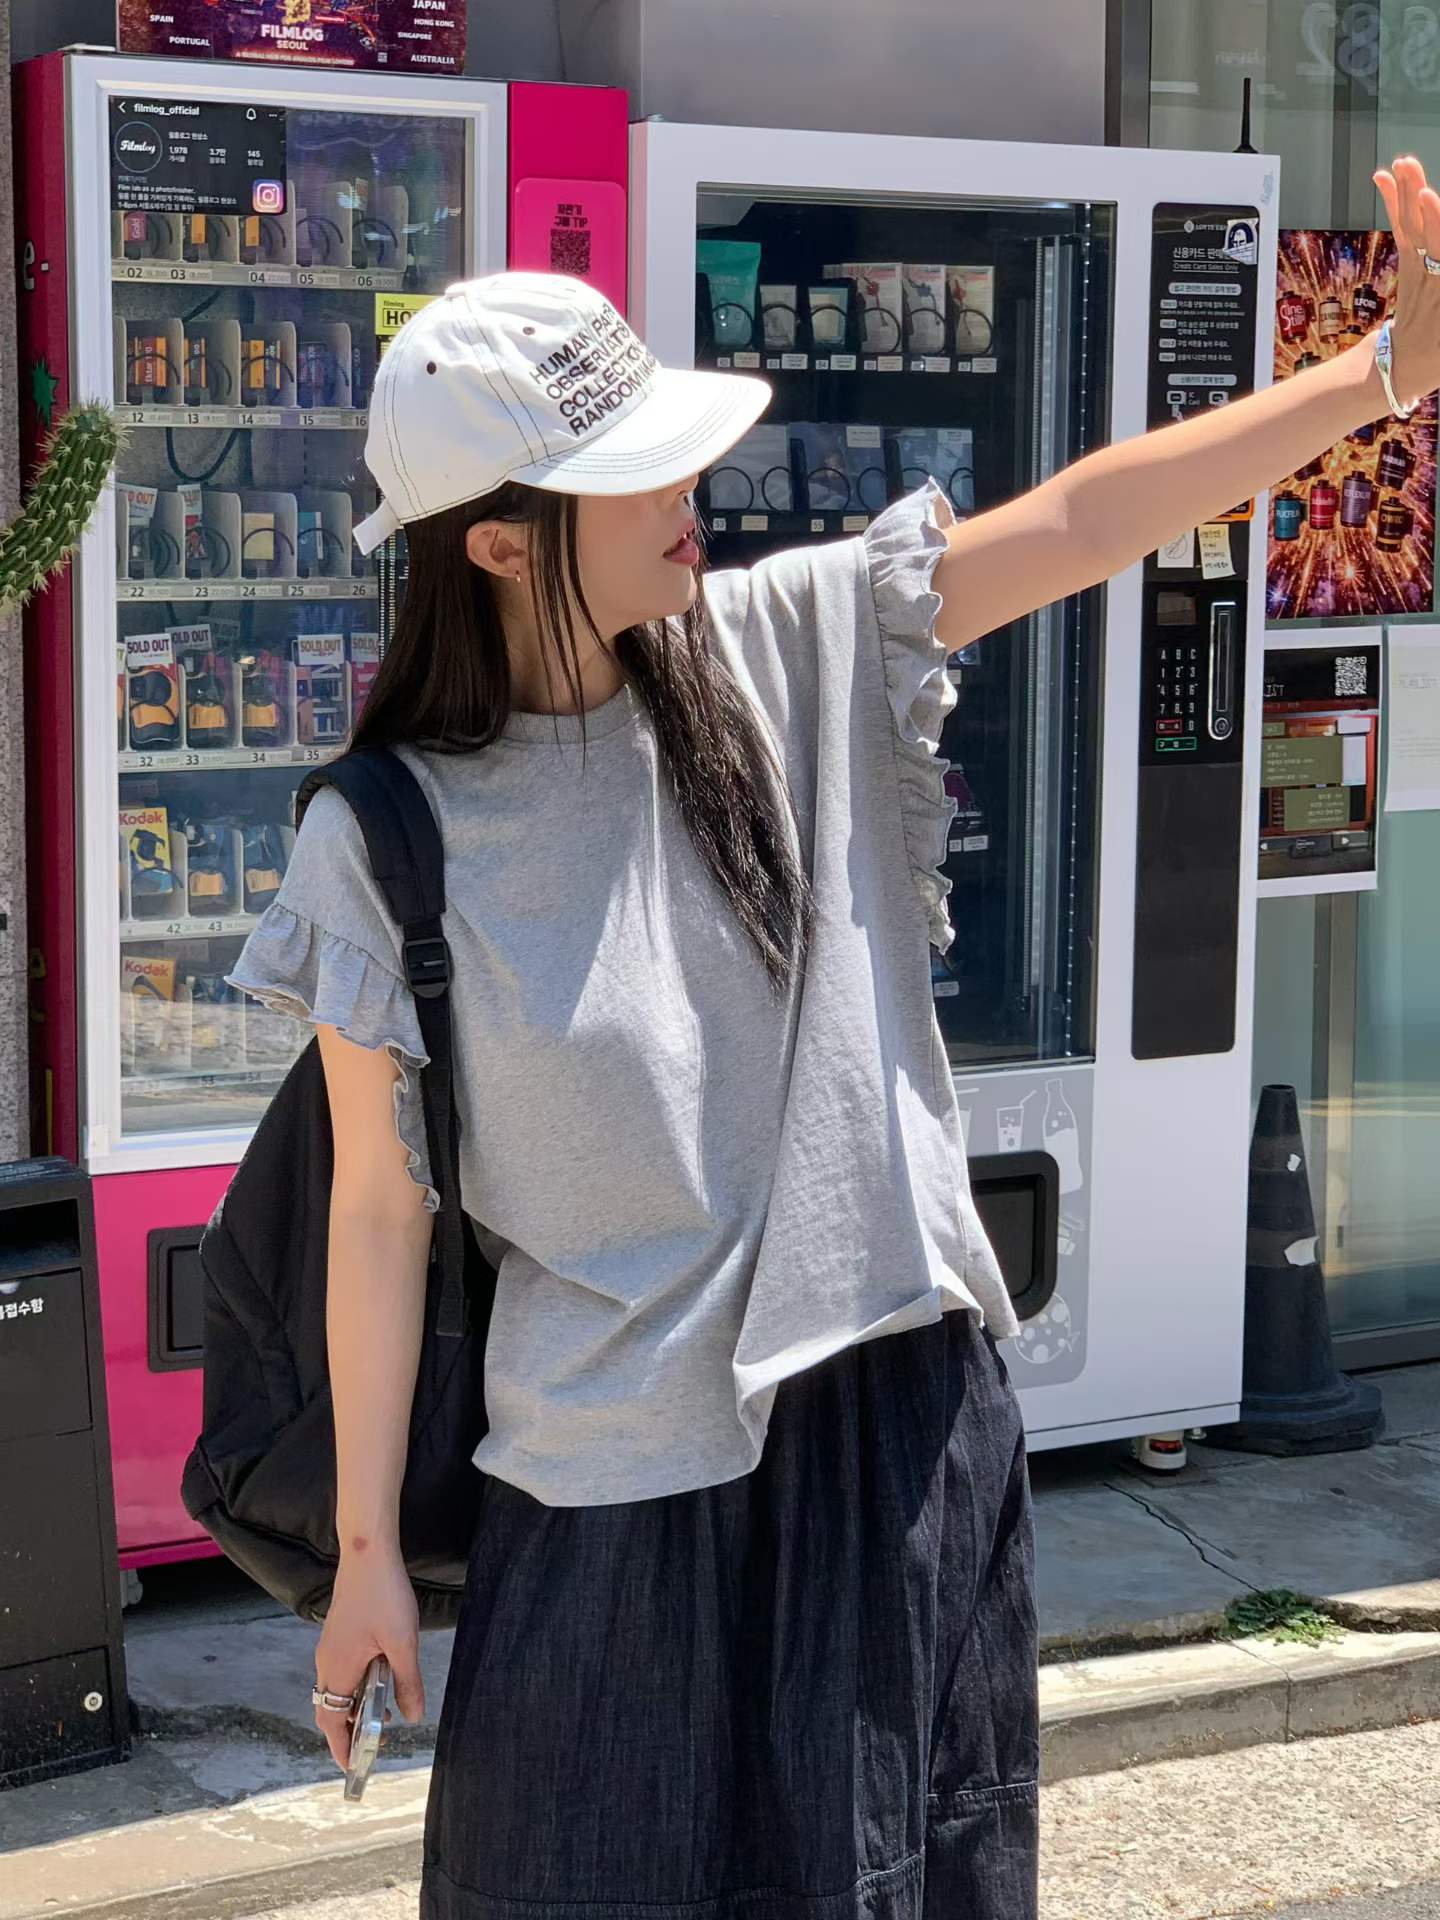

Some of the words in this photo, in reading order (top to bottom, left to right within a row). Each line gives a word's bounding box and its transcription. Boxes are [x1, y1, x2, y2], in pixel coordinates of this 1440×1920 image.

[412, 0, 446, 10] JAPAN
[150, 14, 174, 23] SPAIN
[414, 18, 434, 26] HONG
[435, 19, 455, 28] KONG
[261, 24, 325, 41] FILMLOG
[398, 31, 433, 40] SINGAPORE
[169, 36, 211, 47] PORTUGAL
[276, 40, 309, 50] SEOUL
[411, 54, 455, 64] AUSTRALIA
[133, 103, 200, 116] filmlog_official
[120, 140, 156, 154] Filmlog
[572, 217, 588, 228] TIP
[1173, 247, 1206, 259] 신용카드
[127, 267, 143, 279] 02
[170, 268, 186, 280] 03
[250, 272, 266, 283] 04
[299, 273, 314, 285] 05
[357, 276, 373, 287] 06
[386, 310, 418, 326] HO
[529, 329, 592, 385] HUMAN
[569, 373, 640, 437] RANDOM
[132, 412, 144, 423] 12
[187, 413, 200, 424] 13
[242, 415, 254, 425] 14
[303, 416, 314, 426] 15
[355, 416, 367, 427] 16
[130, 587, 145, 598] 22
[194, 587, 209, 598] 23
[242, 586, 257, 597] 24
[290, 586, 304, 596] 25
[352, 585, 366, 596] 26
[192, 629, 210, 642] OUT
[126, 641, 151, 654] SOLD
[151, 638, 170, 652] OUT
[1160, 649, 1167, 660] A
[1175, 649, 1182, 660] B
[1190, 649, 1197, 660] C
[1175, 667, 1182, 678] 2
[1189, 667, 1196, 678] 3
[1159, 685, 1166, 696] 4
[1174, 684, 1181, 696] 5
[1189, 684, 1195, 696] 6
[1159, 703, 1166, 714] 7
[1174, 703, 1181, 714] 8
[1189, 702, 1195, 713] 9
[1188, 720, 1195, 731] 0
[185, 755, 200, 765] 33
[252, 752, 266, 763] 34
[307, 750, 320, 760] 35
[140, 756, 153, 767] 32
[119, 811, 163, 825] Kodak
[166, 923, 181, 934] 42
[207, 921, 223, 932] 43
[124, 959, 170, 977] Kodak
